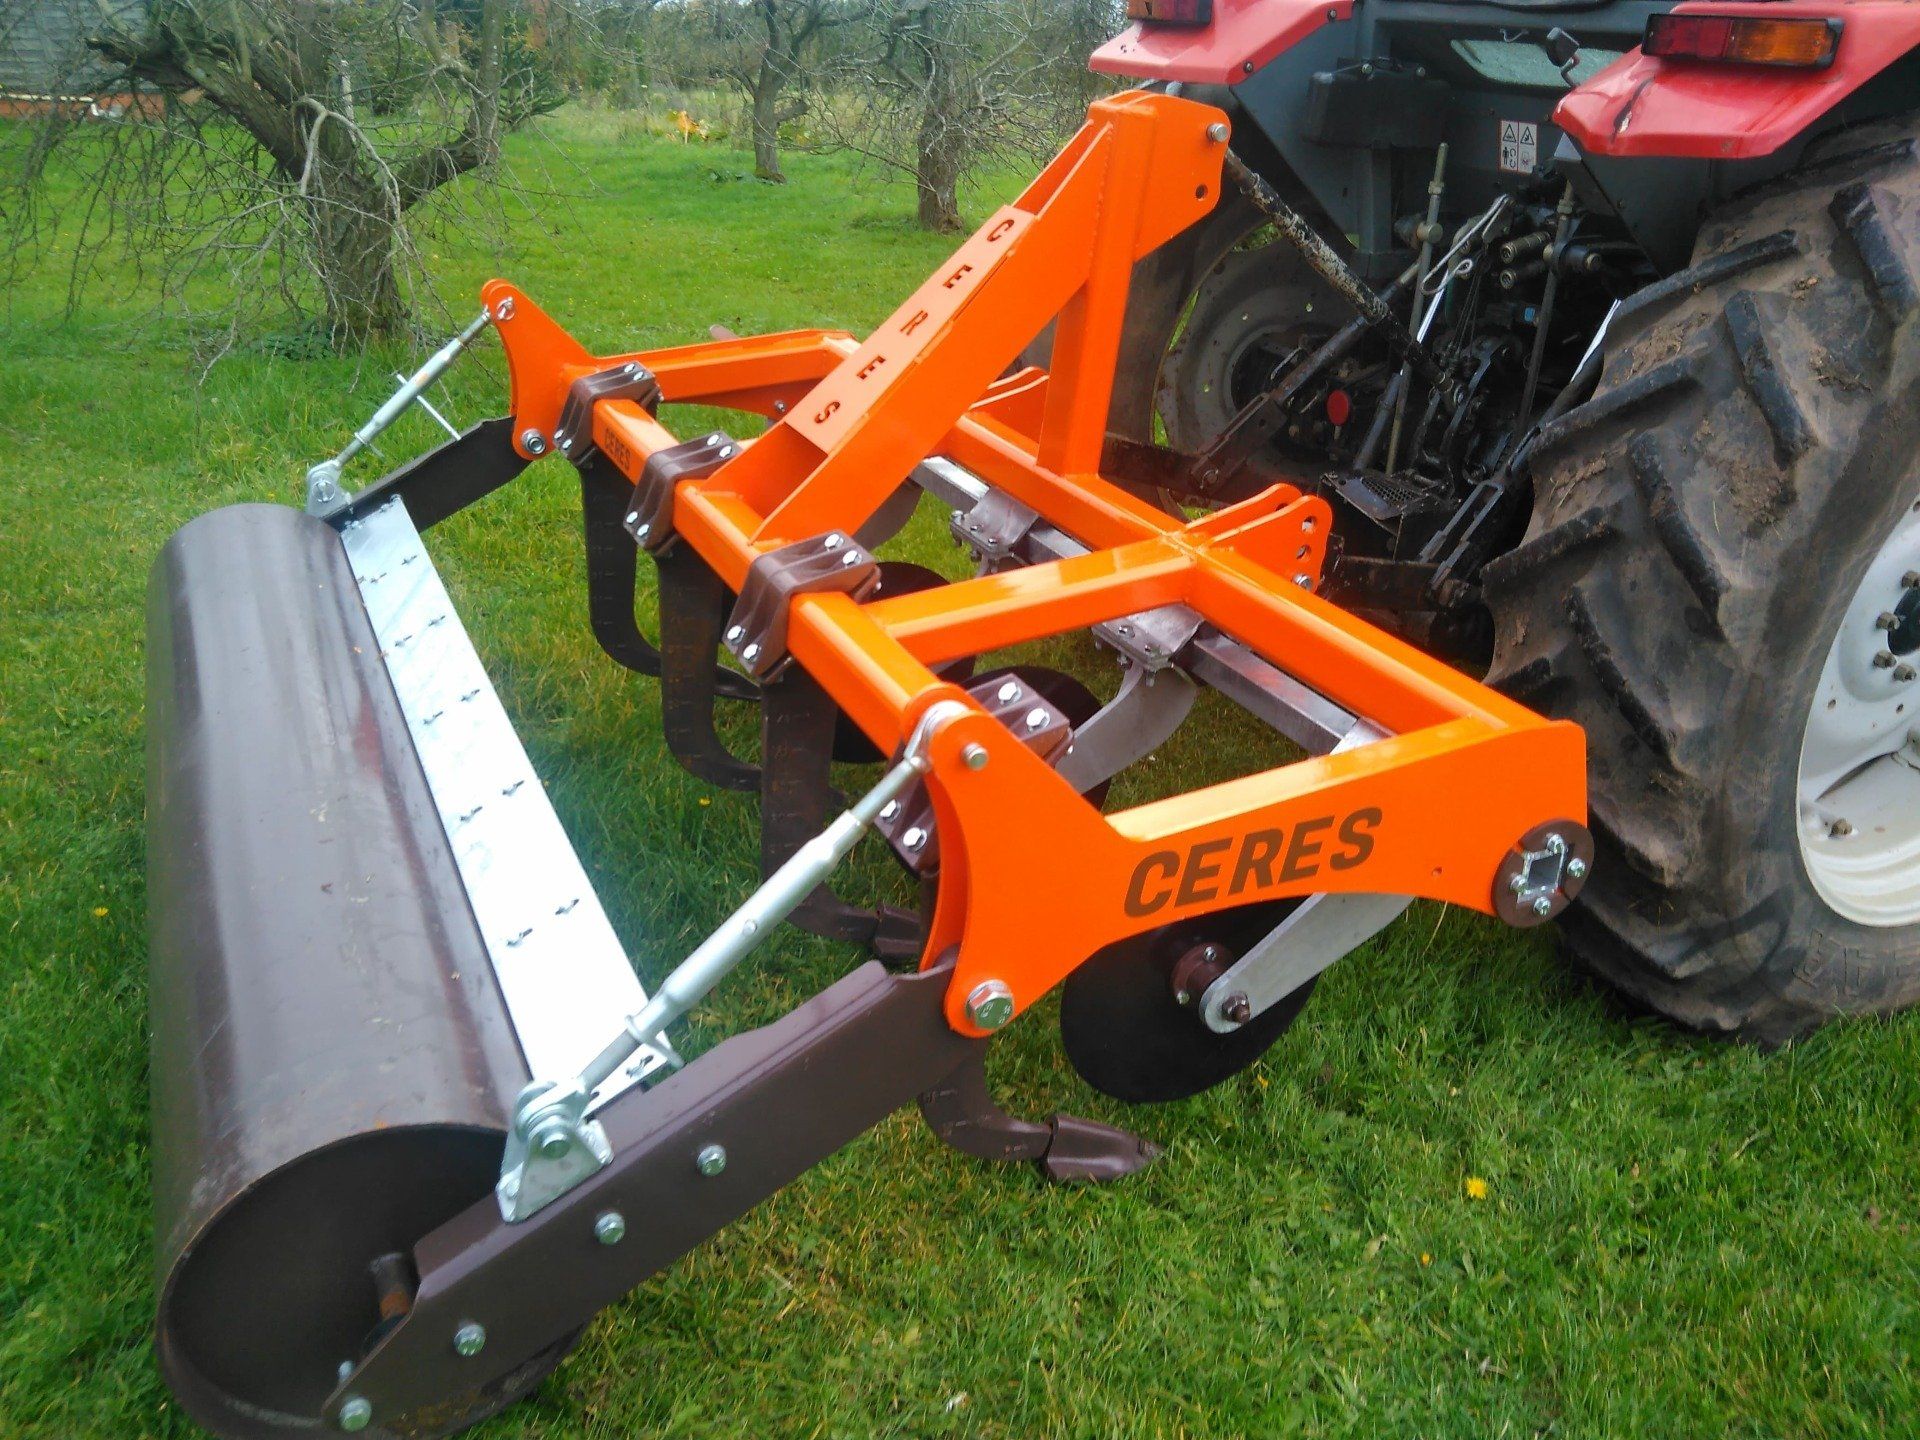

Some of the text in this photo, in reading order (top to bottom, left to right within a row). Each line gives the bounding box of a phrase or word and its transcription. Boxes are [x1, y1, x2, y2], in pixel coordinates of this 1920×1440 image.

[814, 219, 1015, 424] CERES
[604, 427, 631, 471] CERES
[1123, 807, 1383, 918] CERES
